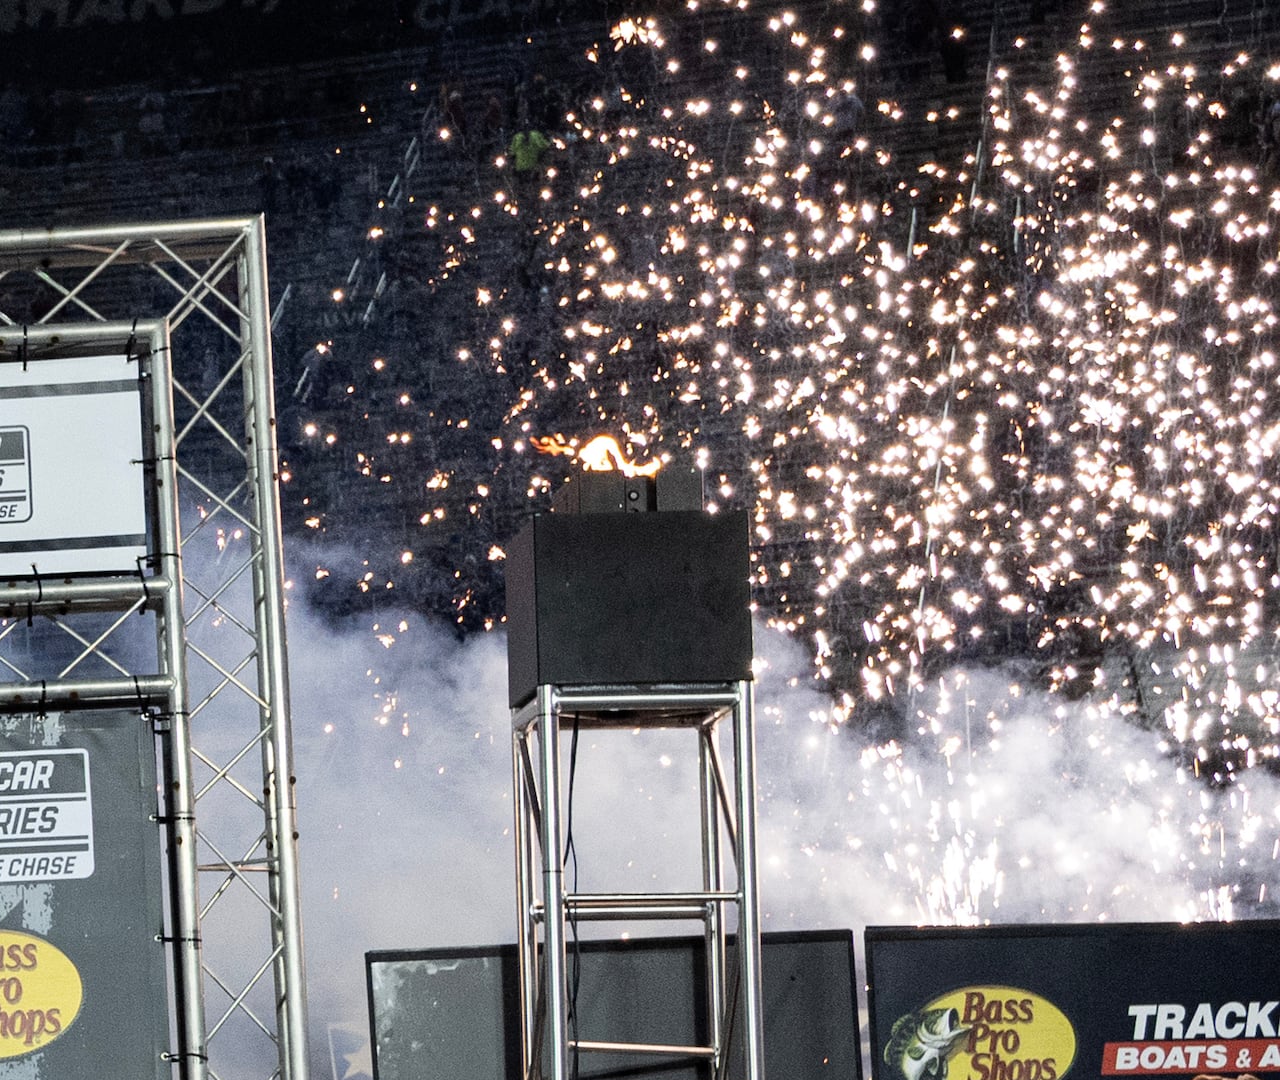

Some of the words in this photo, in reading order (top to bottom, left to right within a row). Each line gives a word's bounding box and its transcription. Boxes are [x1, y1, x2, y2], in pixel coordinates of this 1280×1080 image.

[7, 856, 77, 876] CHASE
[961, 991, 1034, 1025] Bass
[1128, 1000, 1280, 1040] TRACK
[966, 1024, 1020, 1055] Pro
[1116, 1044, 1227, 1071] BOATS
[1236, 1048, 1252, 1066] &
